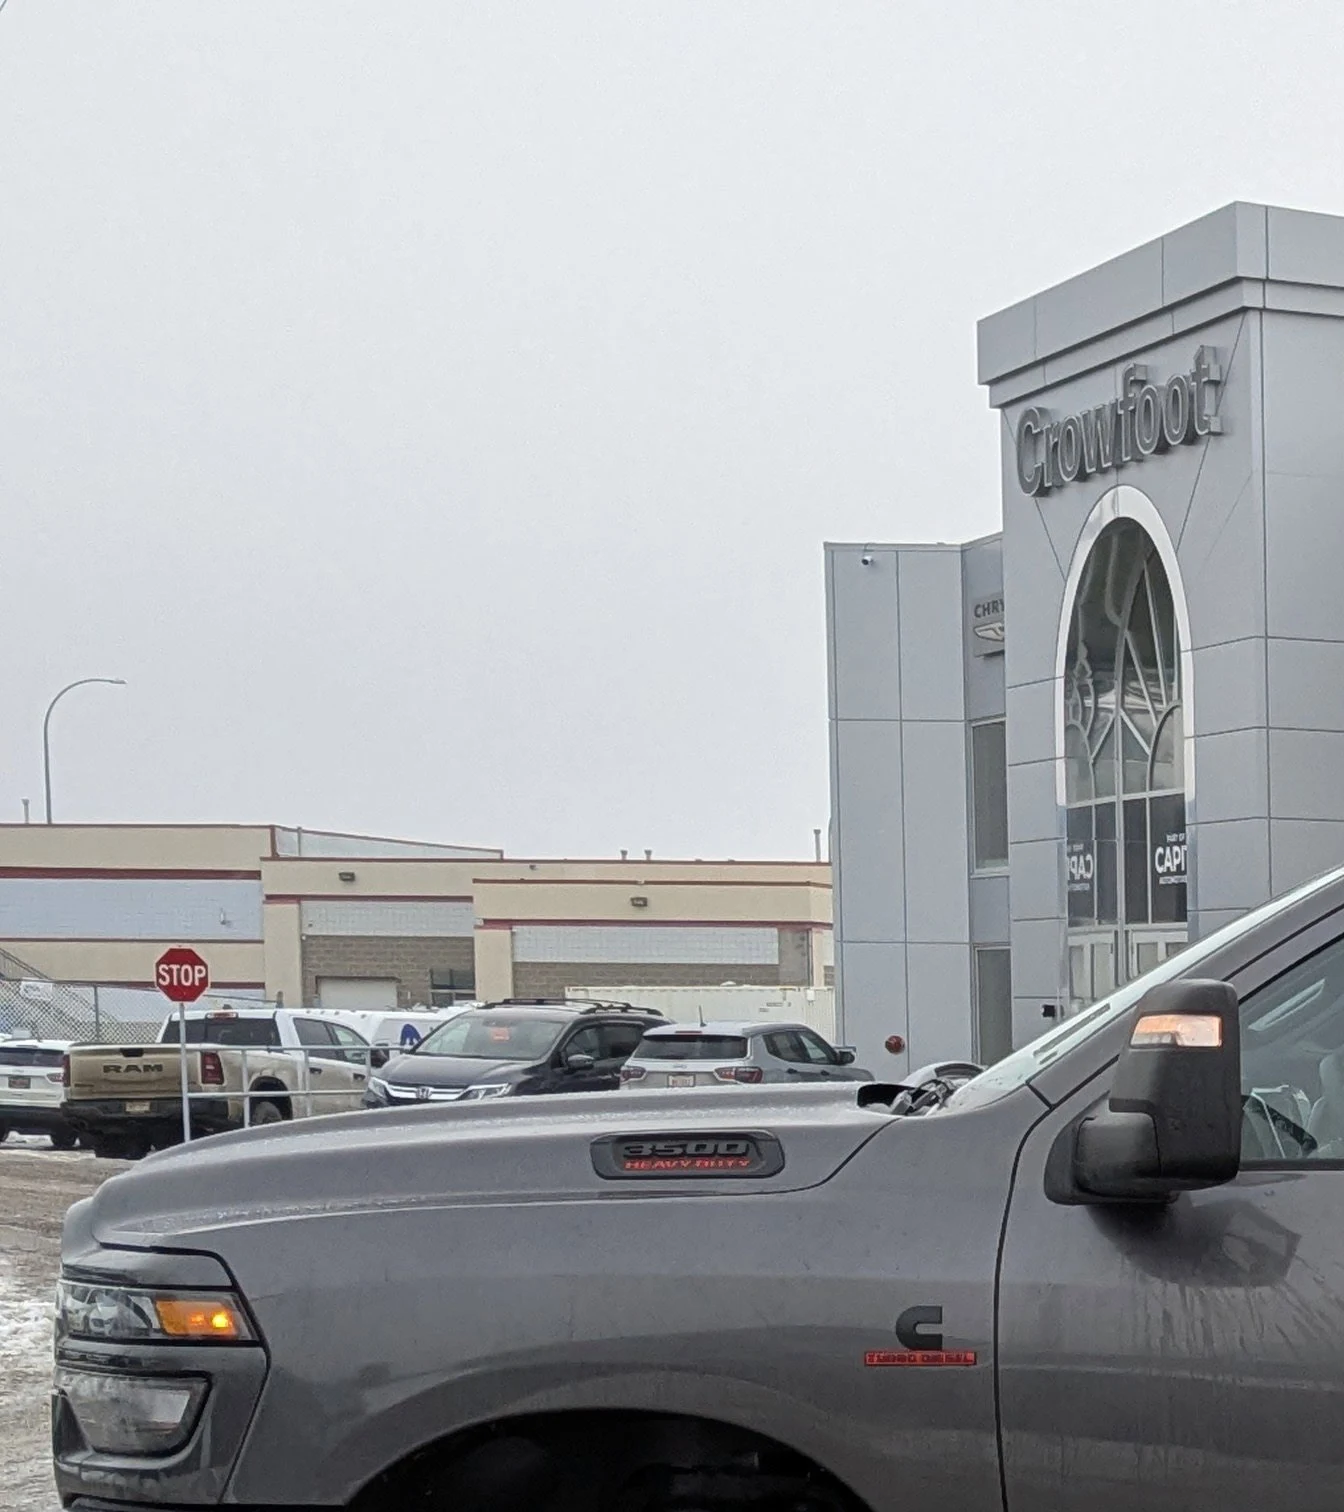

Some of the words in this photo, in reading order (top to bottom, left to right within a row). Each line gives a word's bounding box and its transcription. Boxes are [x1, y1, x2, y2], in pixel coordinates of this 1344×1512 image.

[1017, 345, 1223, 497] Crowfoot
[974, 598, 1004, 618] CHRY
[158, 963, 206, 987] STOP
[102, 1064, 164, 1074] RAM
[623, 1142, 750, 1158] 3500
